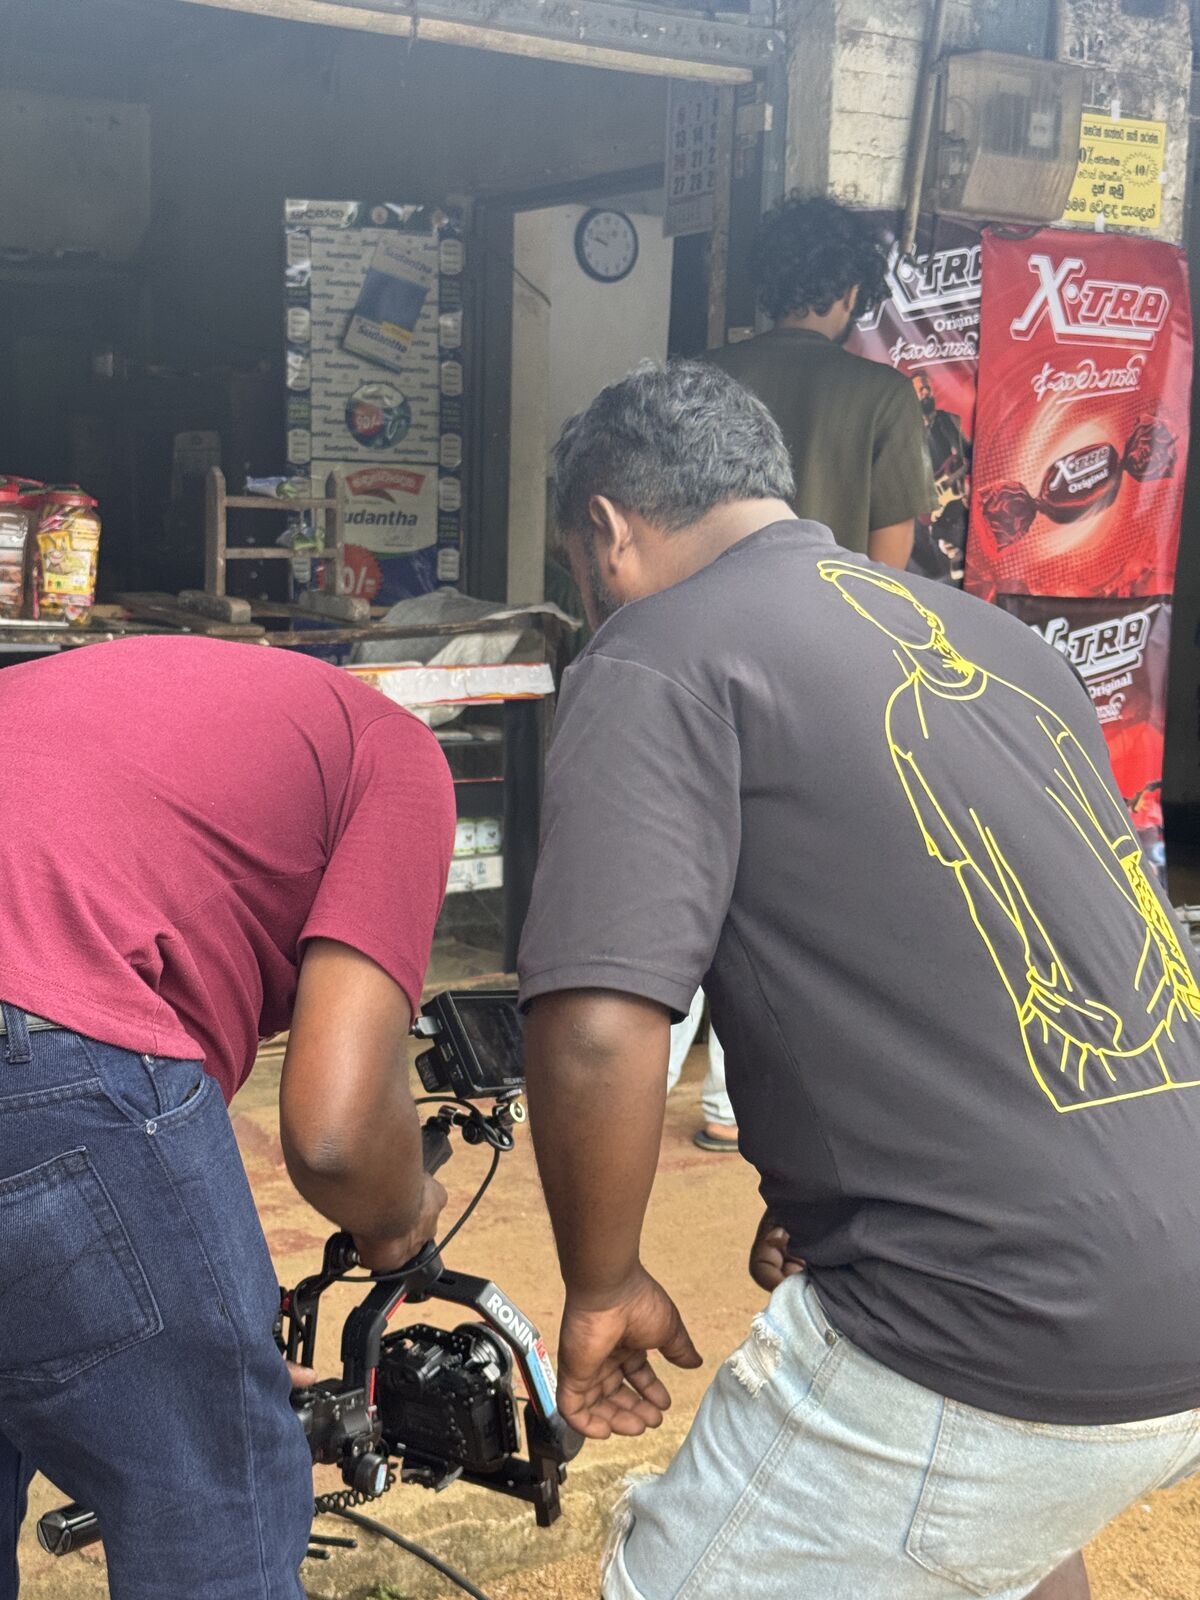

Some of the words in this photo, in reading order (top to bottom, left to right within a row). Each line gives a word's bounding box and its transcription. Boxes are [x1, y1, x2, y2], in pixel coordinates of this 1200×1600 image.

[933, 314, 980, 333] Origina
[344, 509, 418, 527] udantha
[343, 566, 377, 596] 0/=
[486, 1292, 534, 1353] RONIN
